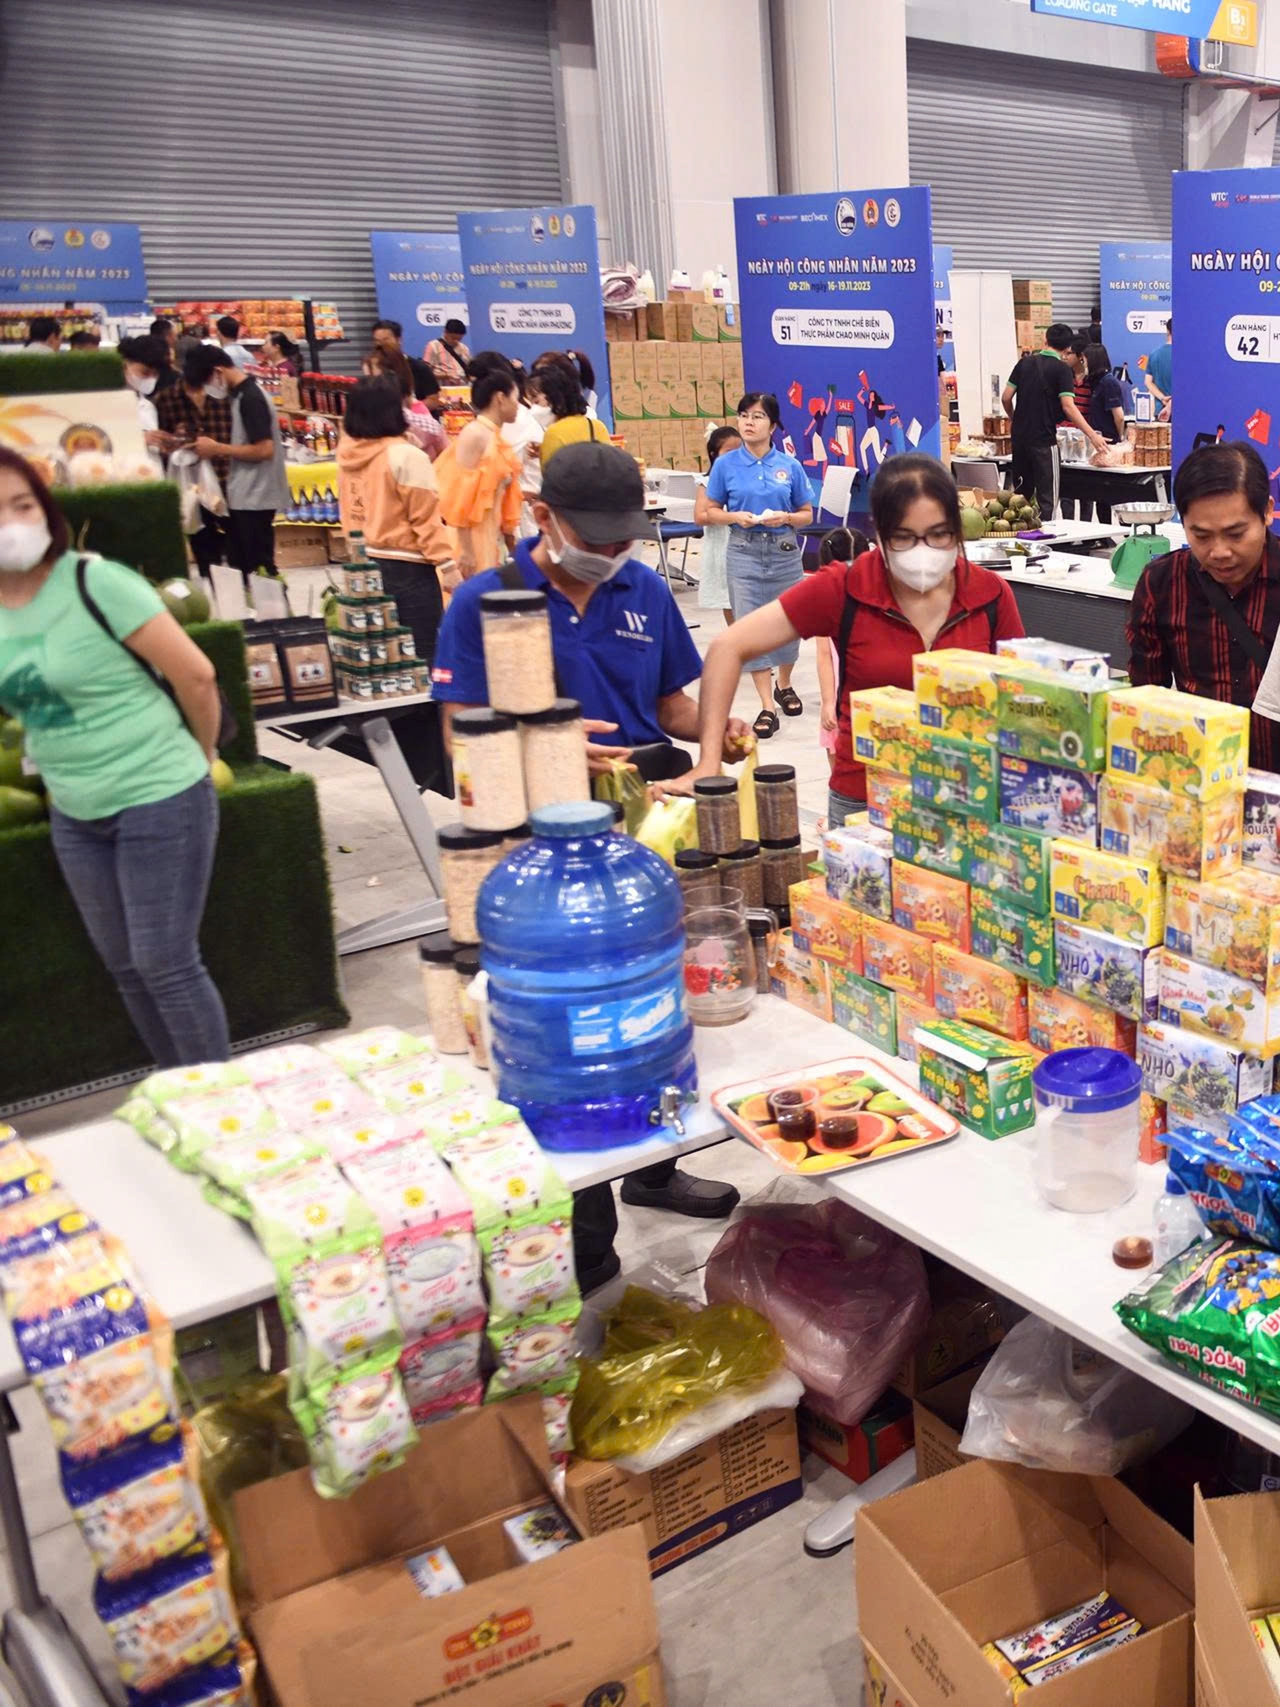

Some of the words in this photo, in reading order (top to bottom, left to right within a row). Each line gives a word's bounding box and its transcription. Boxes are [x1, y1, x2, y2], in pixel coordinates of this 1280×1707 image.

[1092, 3, 1118, 17] GATE
[748, 258, 773, 275] NGÀY
[777, 258, 794, 276] HỘI
[797, 257, 825, 274] CÔNG
[829, 257, 859, 273] NHÂN
[862, 256, 887, 273] NĂM
[891, 258, 916, 273] 2023
[1191, 249, 1235, 271] NGÀY
[1241, 249, 1270, 275] HỘI
[21, 267, 60, 278] NHÂN
[65, 267, 96, 279] NĂM
[102, 270, 131, 279] 2023
[389, 272, 419, 283] NGÀY
[422, 273, 442, 284] HỘI
[789, 281, 811, 291] 09-21h
[838, 281, 871, 291] 19.11.2023
[1109, 280, 1130, 290] NGÀY
[1132, 281, 1147, 292] HỘI
[1149, 280, 1170, 290] CÔNG
[426, 314, 440, 323] 66
[808, 316, 825, 327] CÔNG
[825, 319, 833, 327] TY
[834, 319, 851, 327] TNHH
[1133, 321, 1143, 330] 57
[1231, 323, 1247, 331] GIAN
[1249, 323, 1267, 332] HÀNG
[781, 326, 791, 340] 51
[854, 331, 870, 339] MINH
[1237, 337, 1259, 355] 42
[838, 402, 850, 411] SALE
[1060, 950, 1090, 976] NHO
[1141, 1052, 1176, 1078] NHO
[1203, 1346, 1247, 1376] NGỌC
